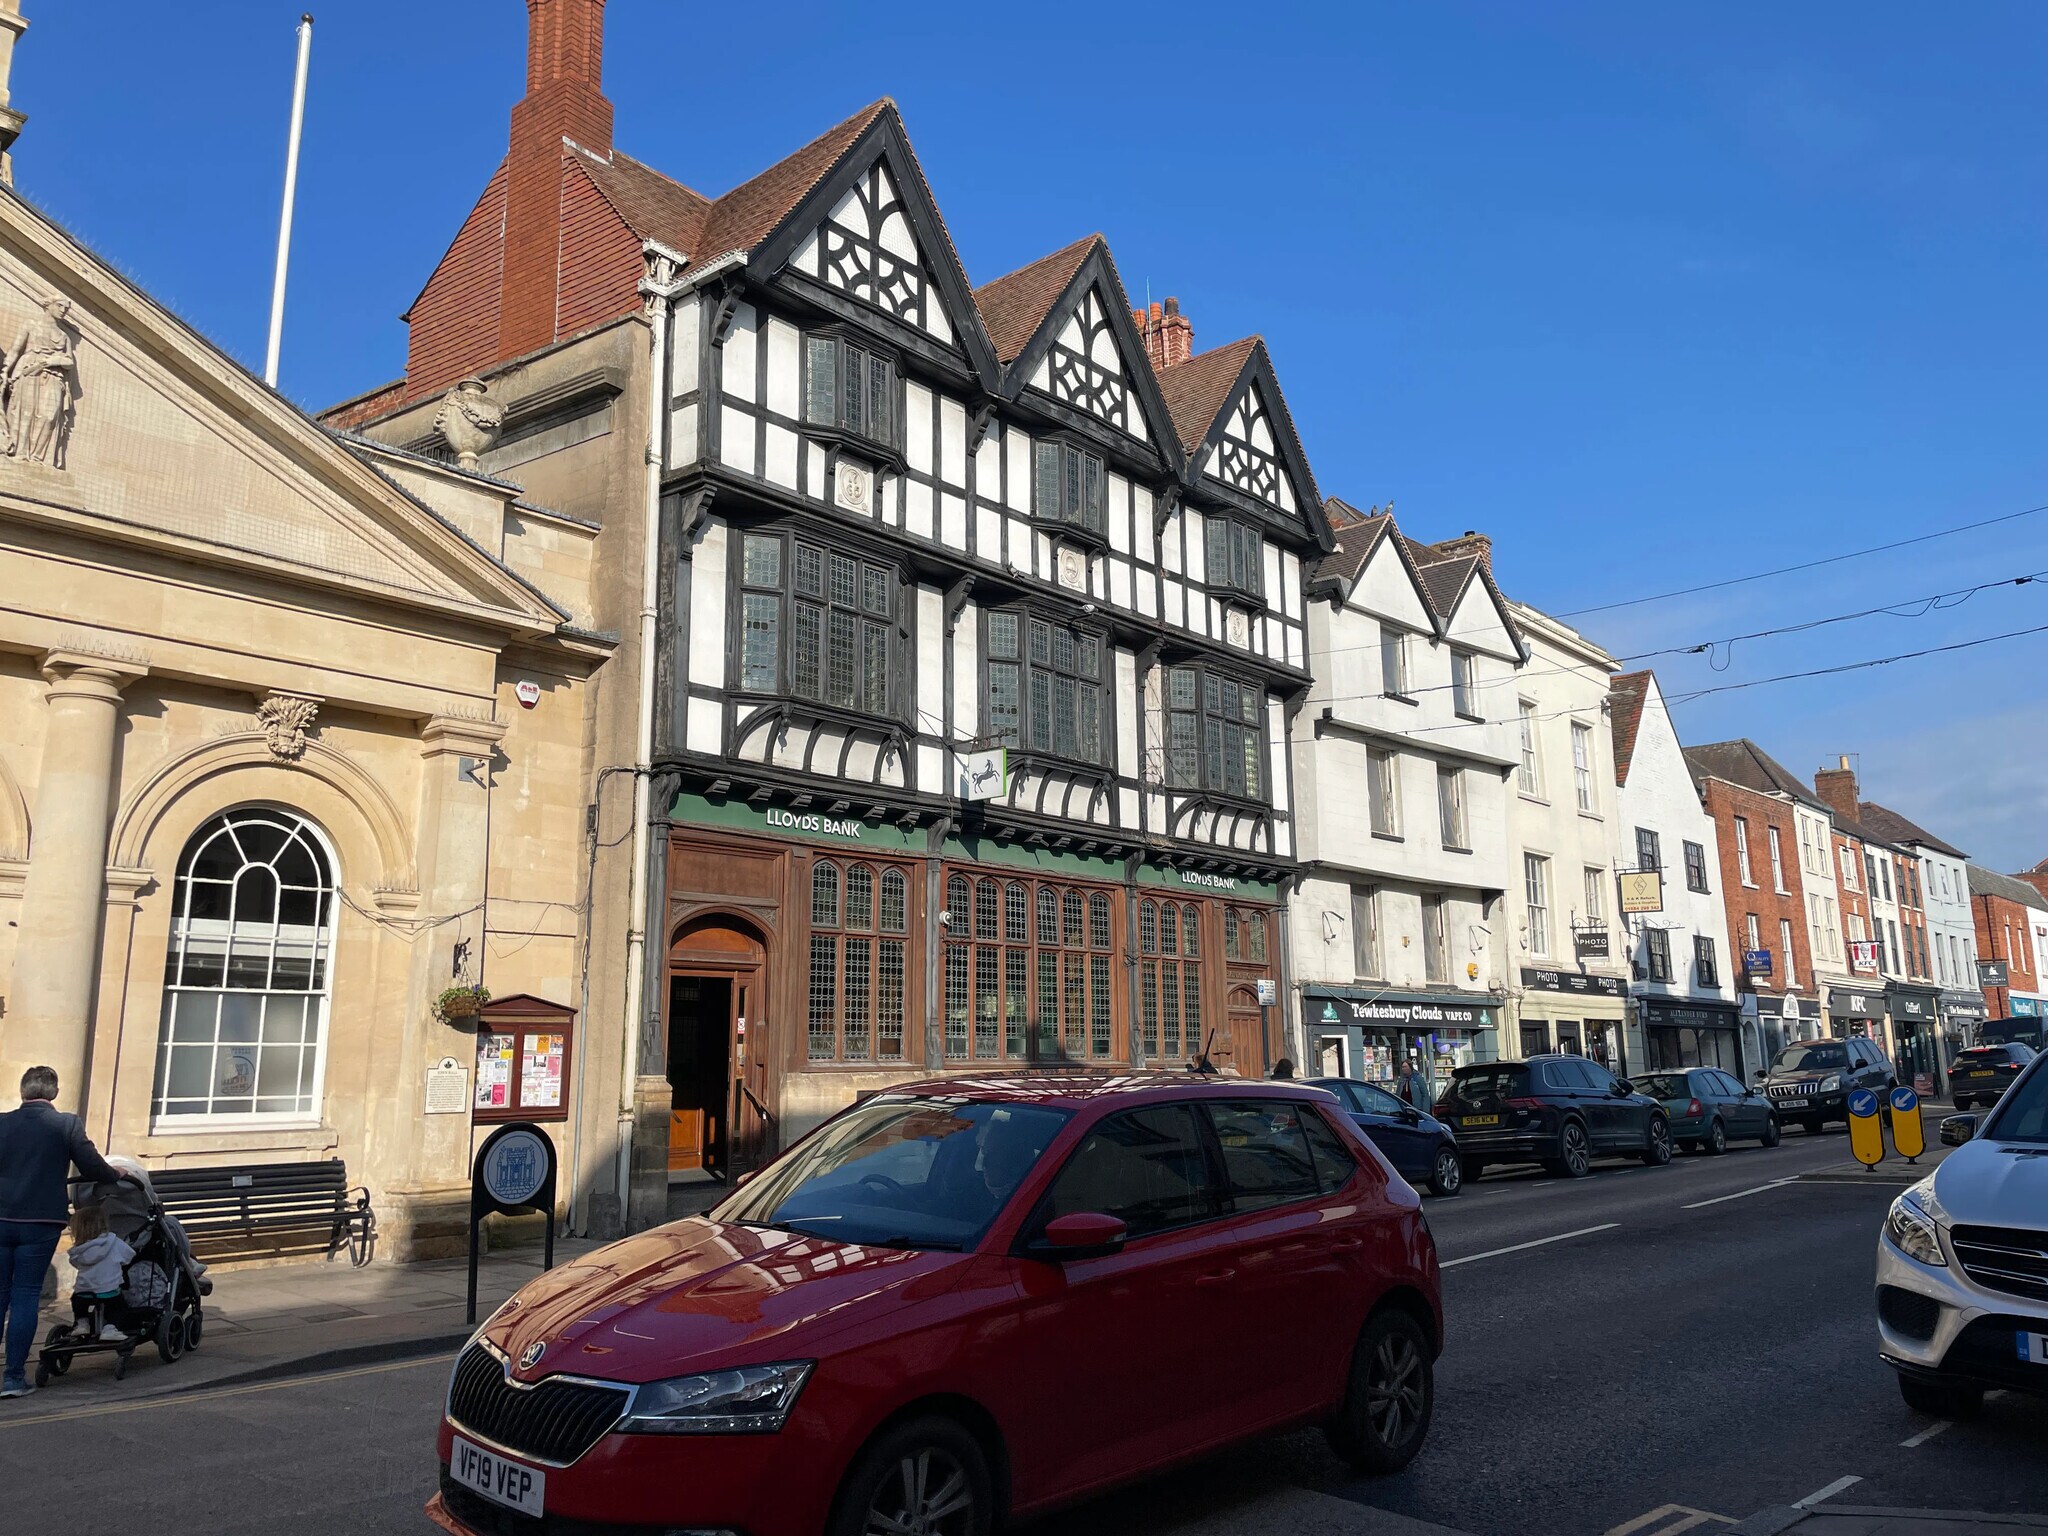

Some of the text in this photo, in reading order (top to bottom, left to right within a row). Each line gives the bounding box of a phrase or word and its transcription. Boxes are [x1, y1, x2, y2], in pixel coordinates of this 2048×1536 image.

[766, 809, 860, 838] LLOYDS BANK
[1182, 871, 1235, 890] LLOYDS BANK
[1536, 971, 1558, 983] PHOTO
[1598, 978, 1617, 989] PHOTO
[1352, 1003, 1472, 1023] Tewkesbury Clouds VAPE CO
[1851, 995, 1866, 1012] KFC
[461, 1444, 532, 1503] VF19 VEP
